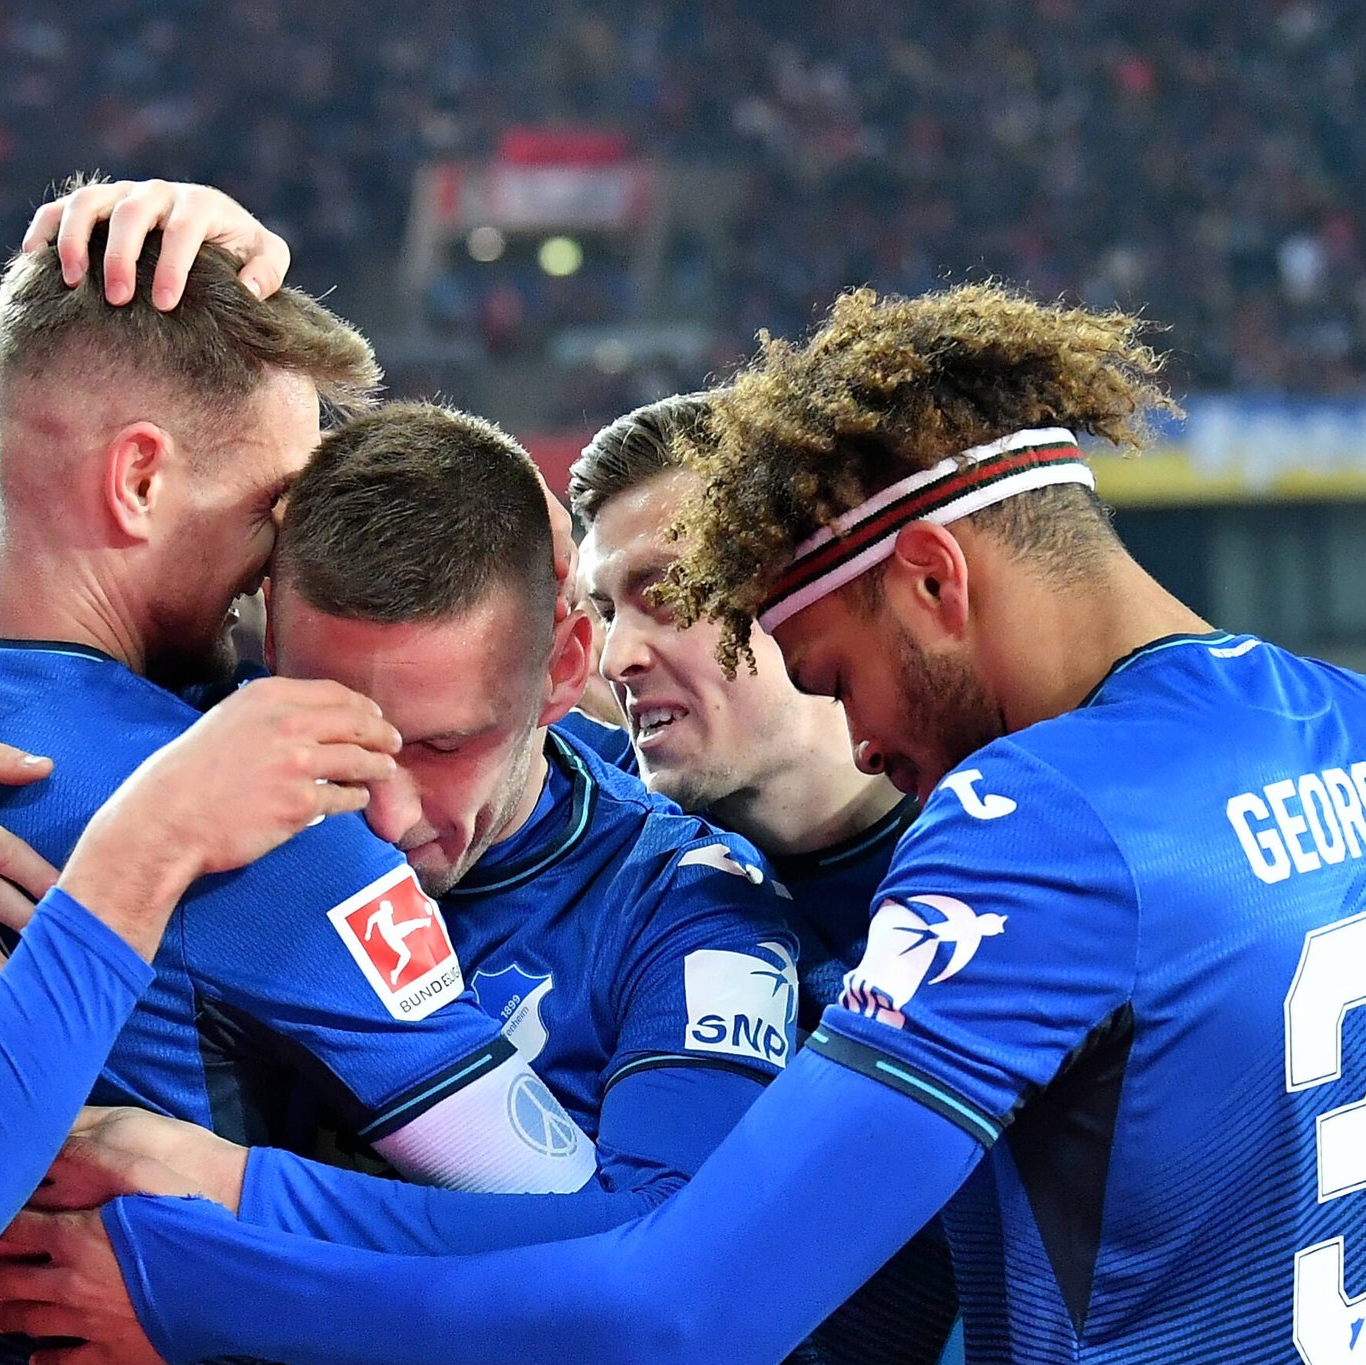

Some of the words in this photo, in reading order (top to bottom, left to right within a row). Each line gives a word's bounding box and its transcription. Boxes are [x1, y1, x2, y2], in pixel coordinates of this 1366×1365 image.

[500, 994, 521, 1019] 1899
[506, 1006, 530, 1037] enheim
[692, 1014, 786, 1060] SNP
